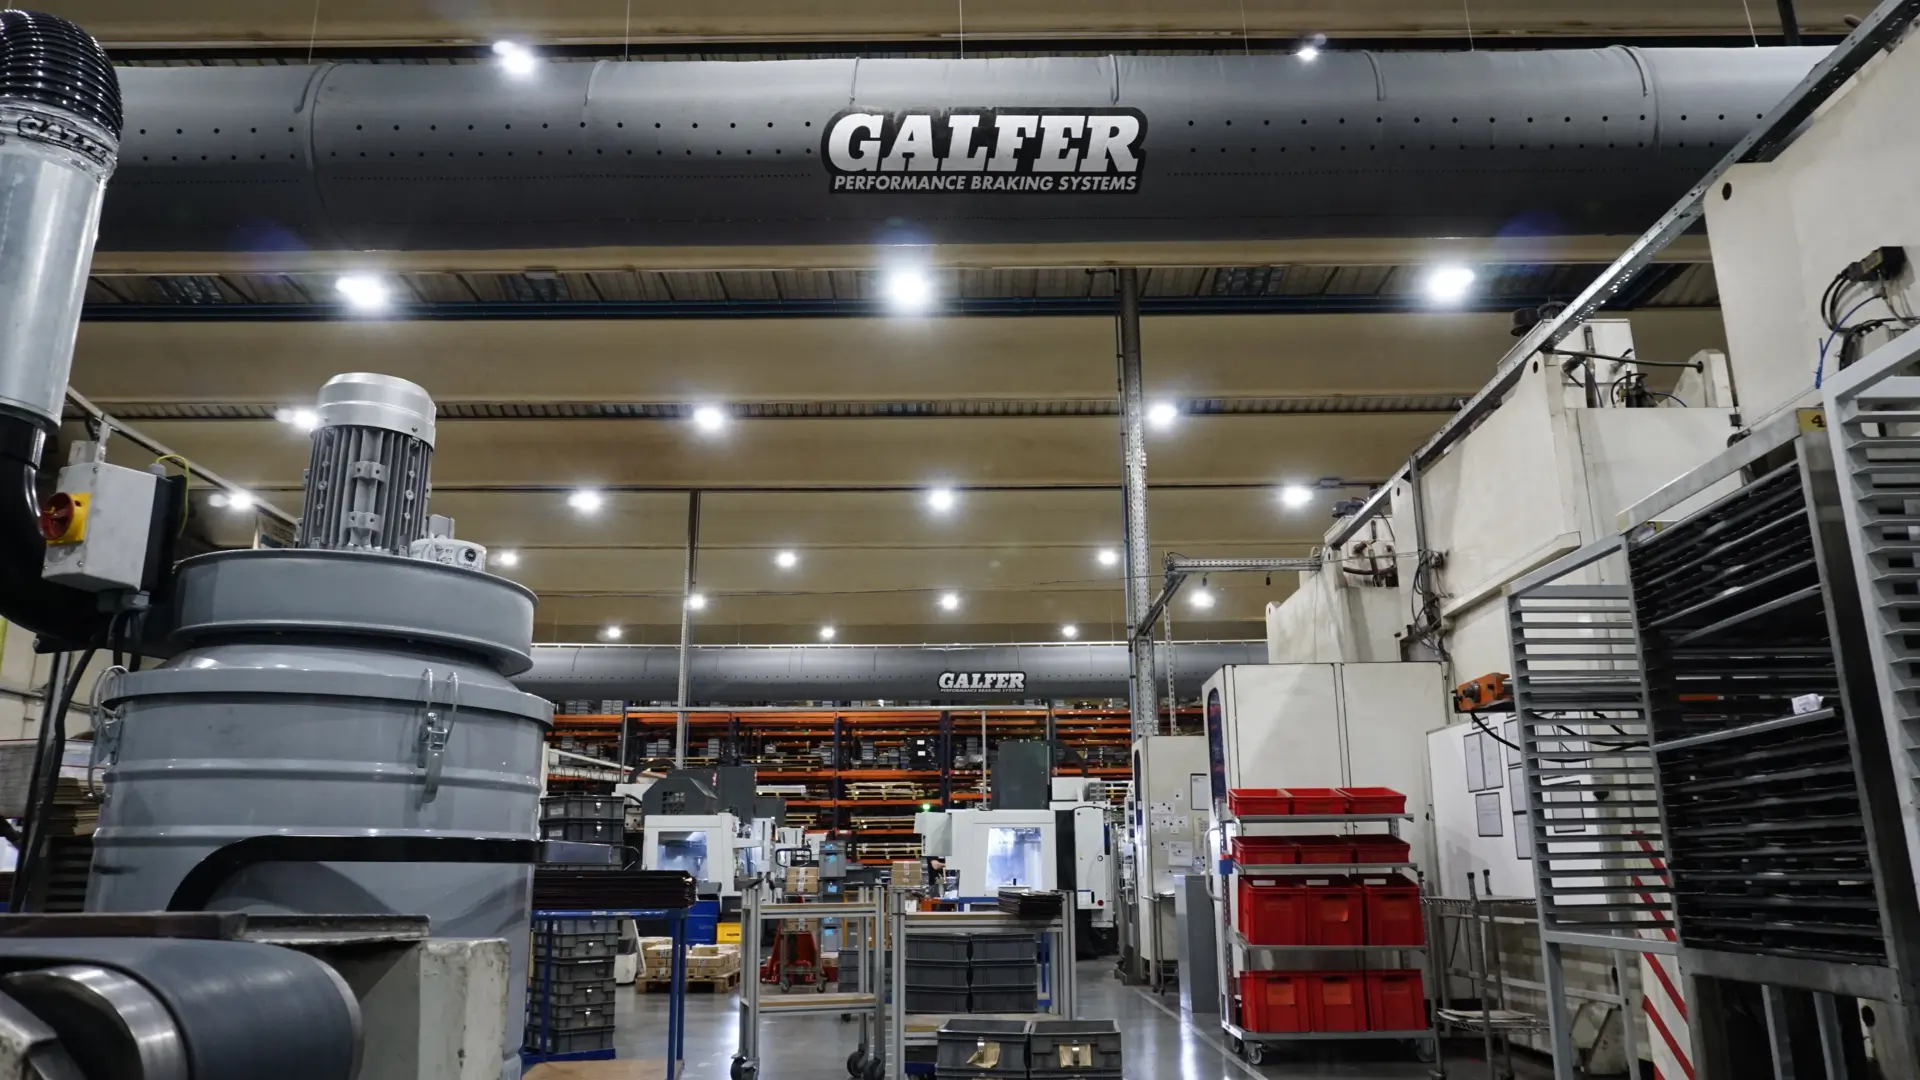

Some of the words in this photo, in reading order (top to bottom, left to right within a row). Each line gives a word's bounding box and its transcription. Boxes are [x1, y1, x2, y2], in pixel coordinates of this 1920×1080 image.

[828, 114, 1140, 172] GALFER
[834, 175, 965, 190] PERFORMANCE
[971, 175, 1053, 191] BRAKING
[1058, 176, 1137, 191] SYSTEMS
[939, 673, 1025, 688] GALFER
